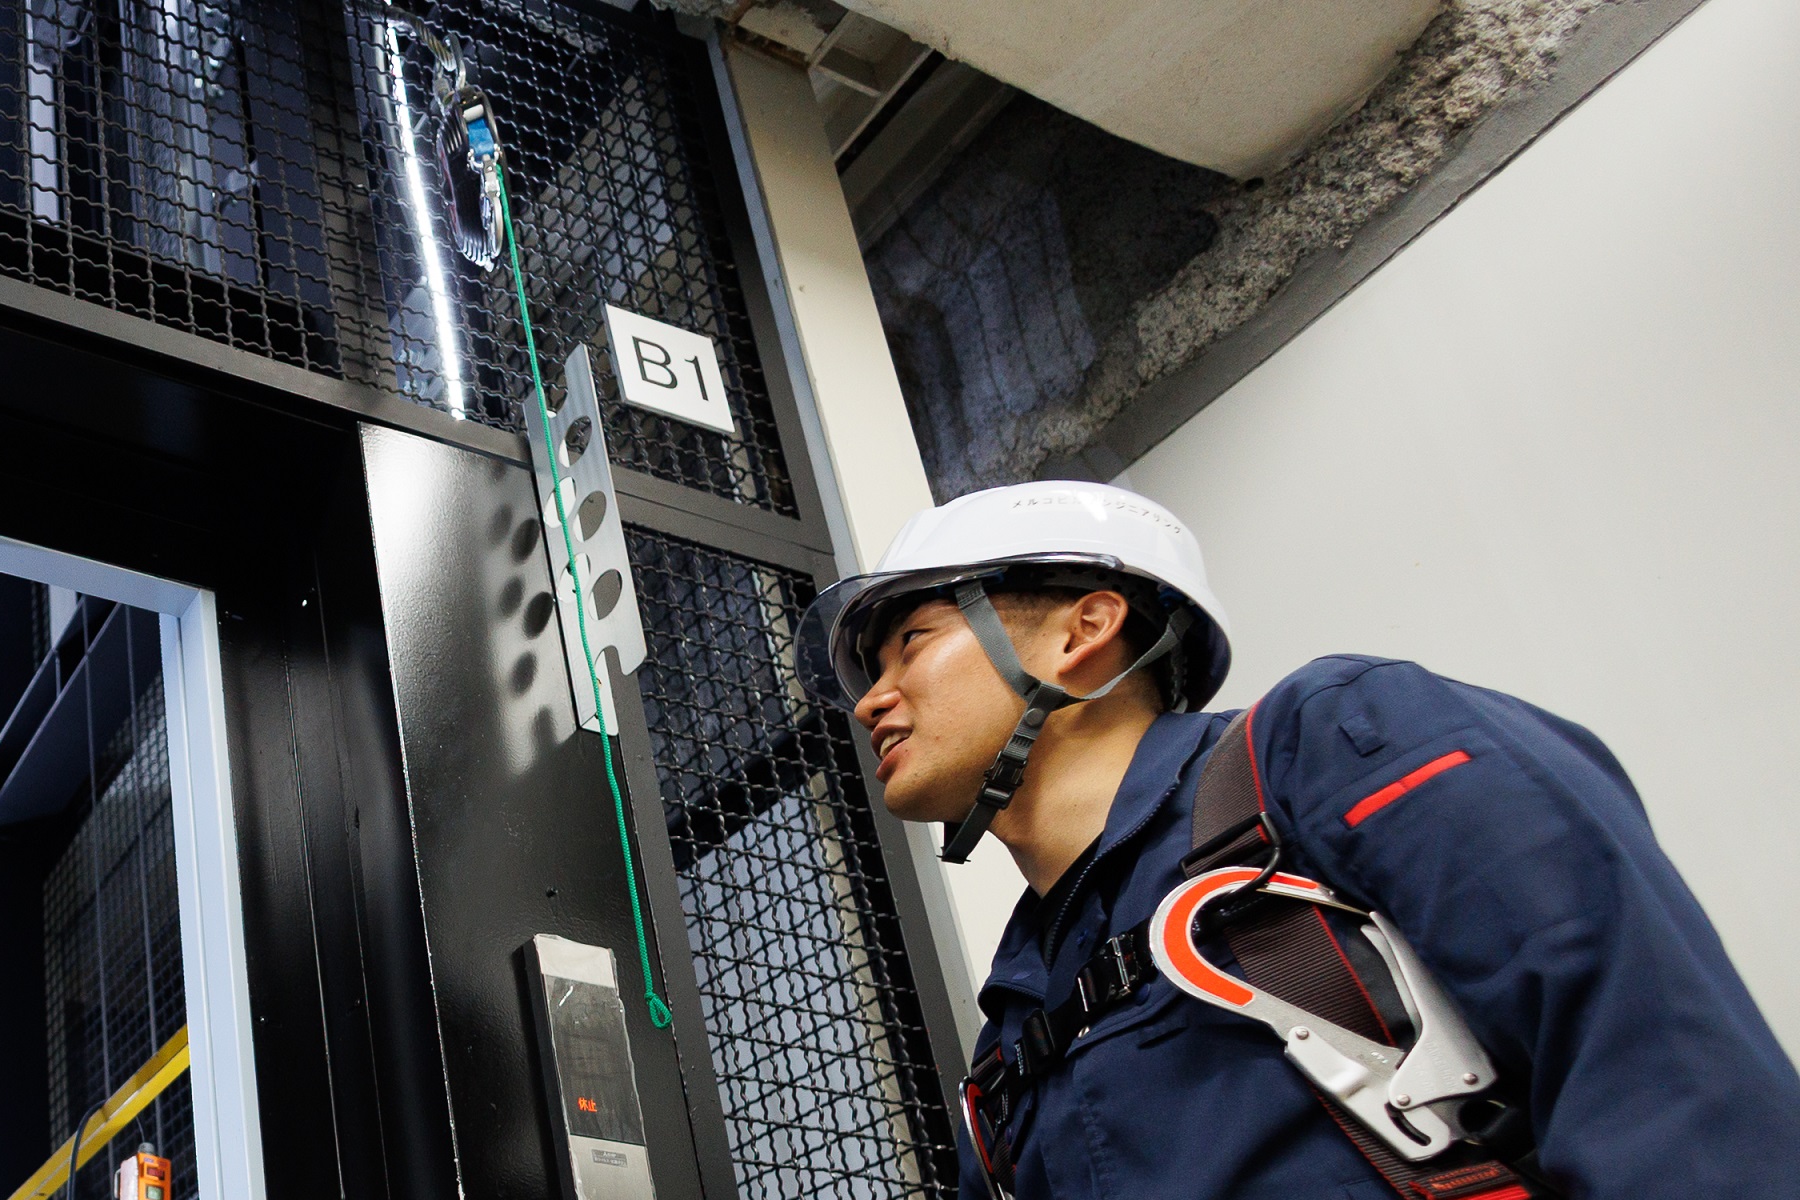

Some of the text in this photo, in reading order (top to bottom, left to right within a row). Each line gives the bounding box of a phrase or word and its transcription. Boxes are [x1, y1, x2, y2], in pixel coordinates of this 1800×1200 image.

[631, 335, 710, 402] B1
[1012, 495, 1182, 535] メルコビルンジニアリング
[577, 1096, 598, 1113] 休止
